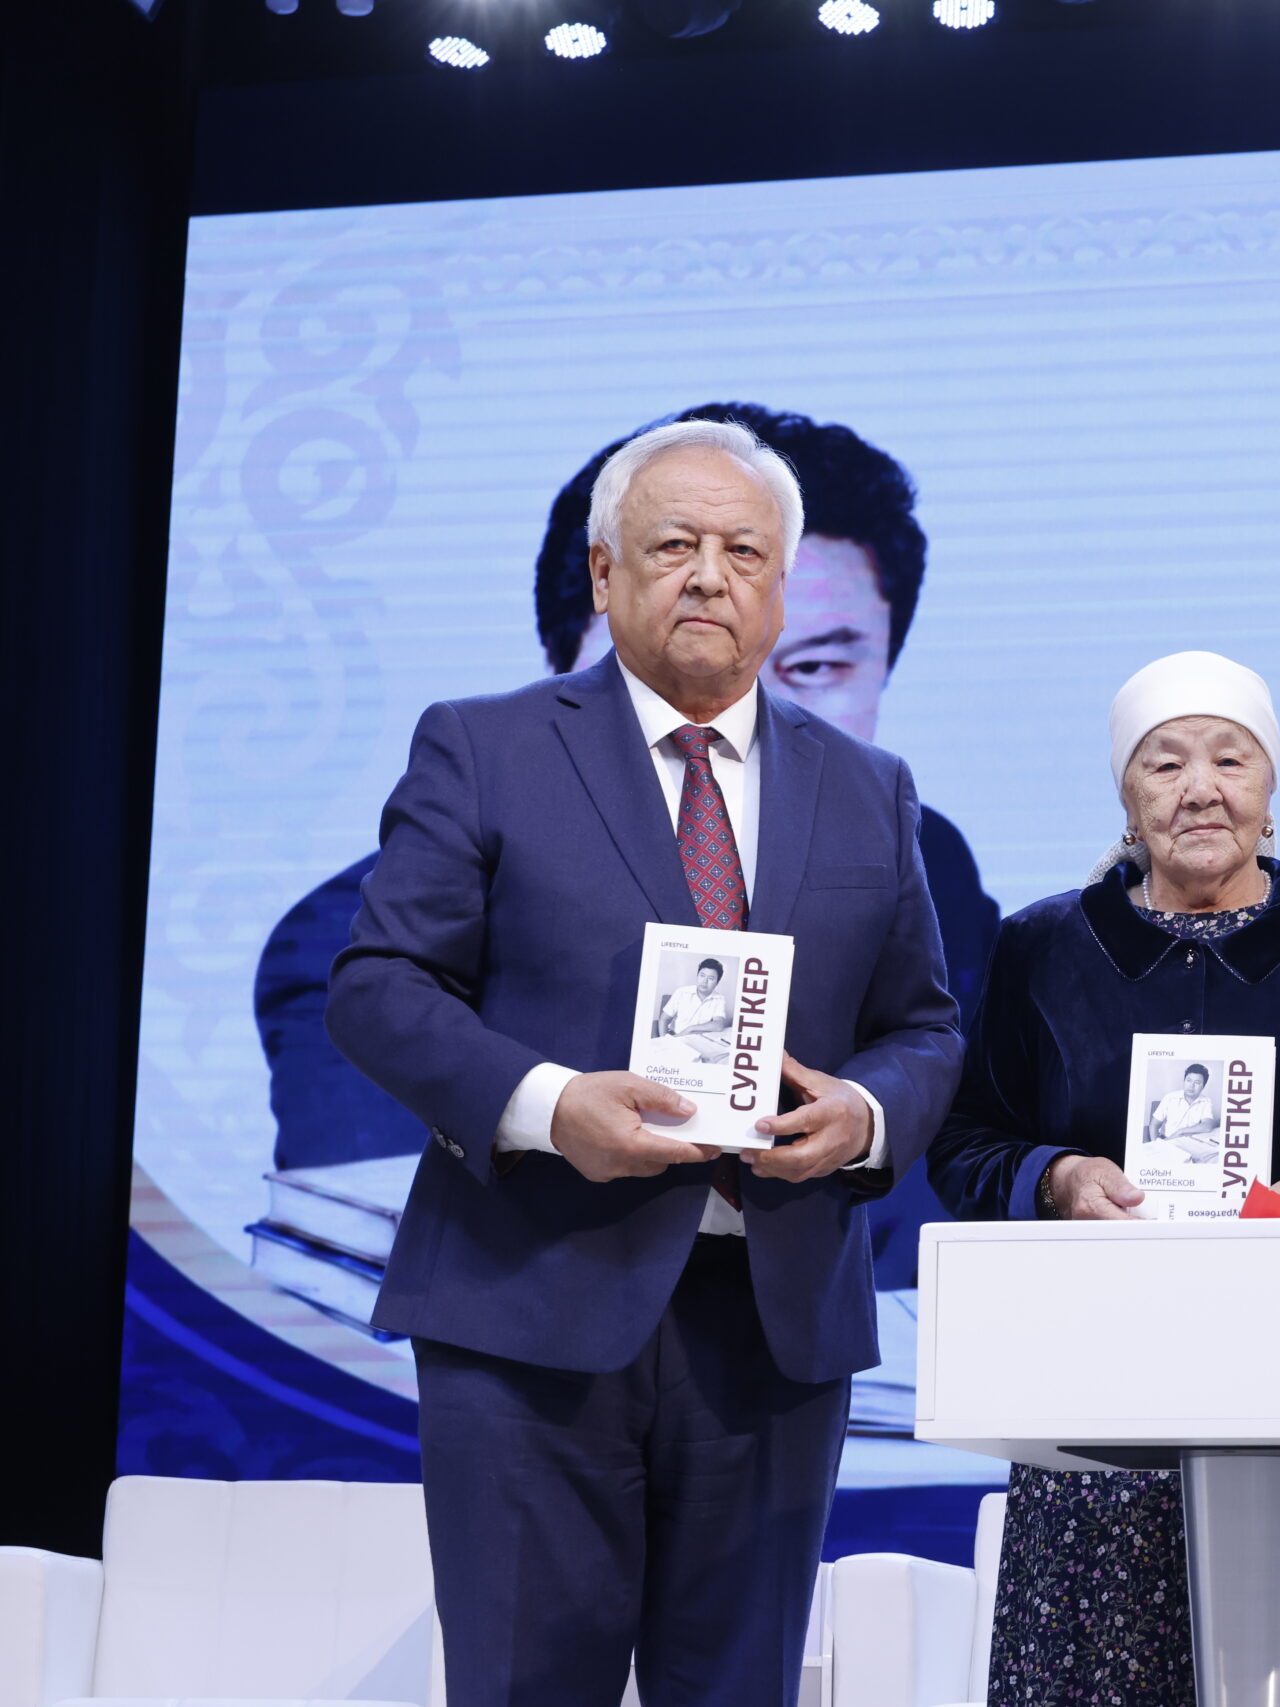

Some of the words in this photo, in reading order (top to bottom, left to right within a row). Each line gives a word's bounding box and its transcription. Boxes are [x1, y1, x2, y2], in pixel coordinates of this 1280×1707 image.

[660, 941, 689, 949] LIFESTYLE
[730, 957, 769, 1112] СУРЕТКЕР
[646, 1065, 680, 1075] САЙЫН
[1139, 1168, 1172, 1176] САЙЫН
[1188, 1208, 1240, 1219] ұратбеков
